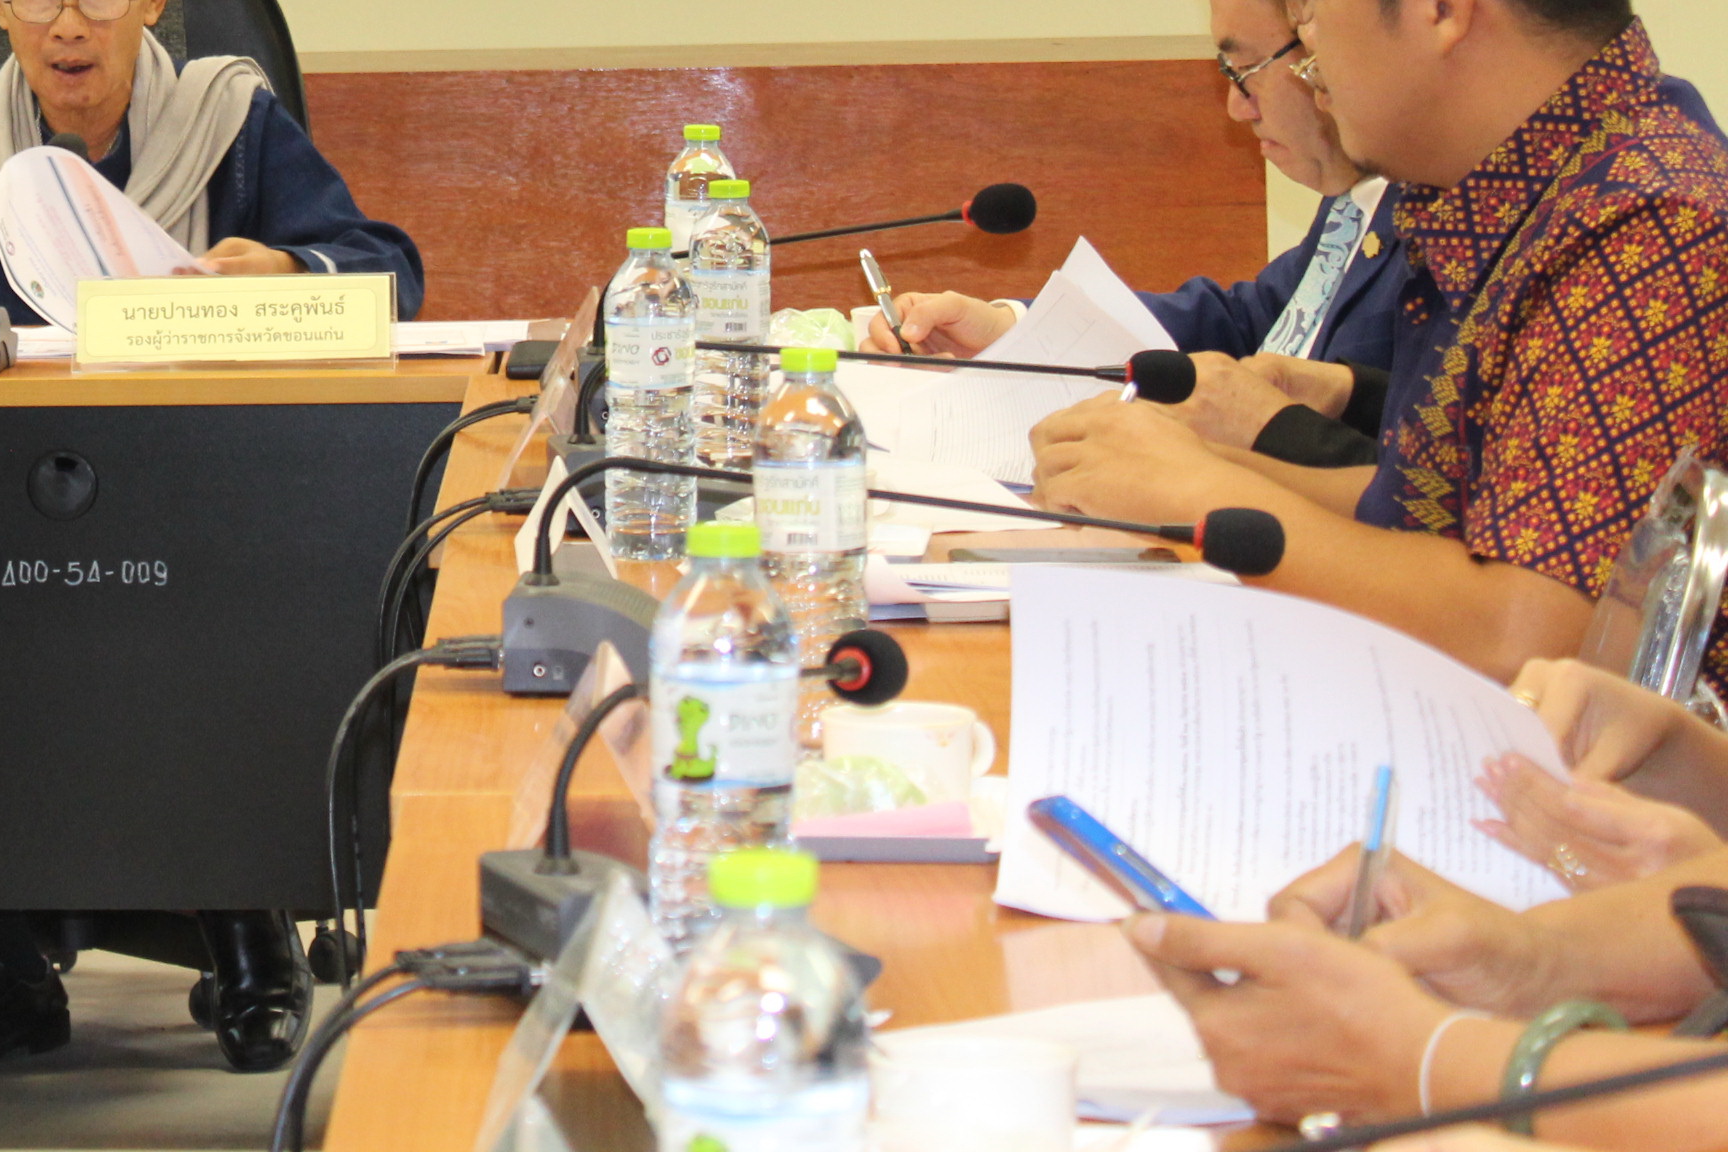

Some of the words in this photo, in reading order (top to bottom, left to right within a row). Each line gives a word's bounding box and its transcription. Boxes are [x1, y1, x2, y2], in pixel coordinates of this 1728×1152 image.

[122, 301, 239, 320] นายปานทอง
[255, 294, 346, 323] สระคูพันธ์
[126, 327, 345, 350] รองผู้ว่าราชการจังหวัดขอนแก่น
